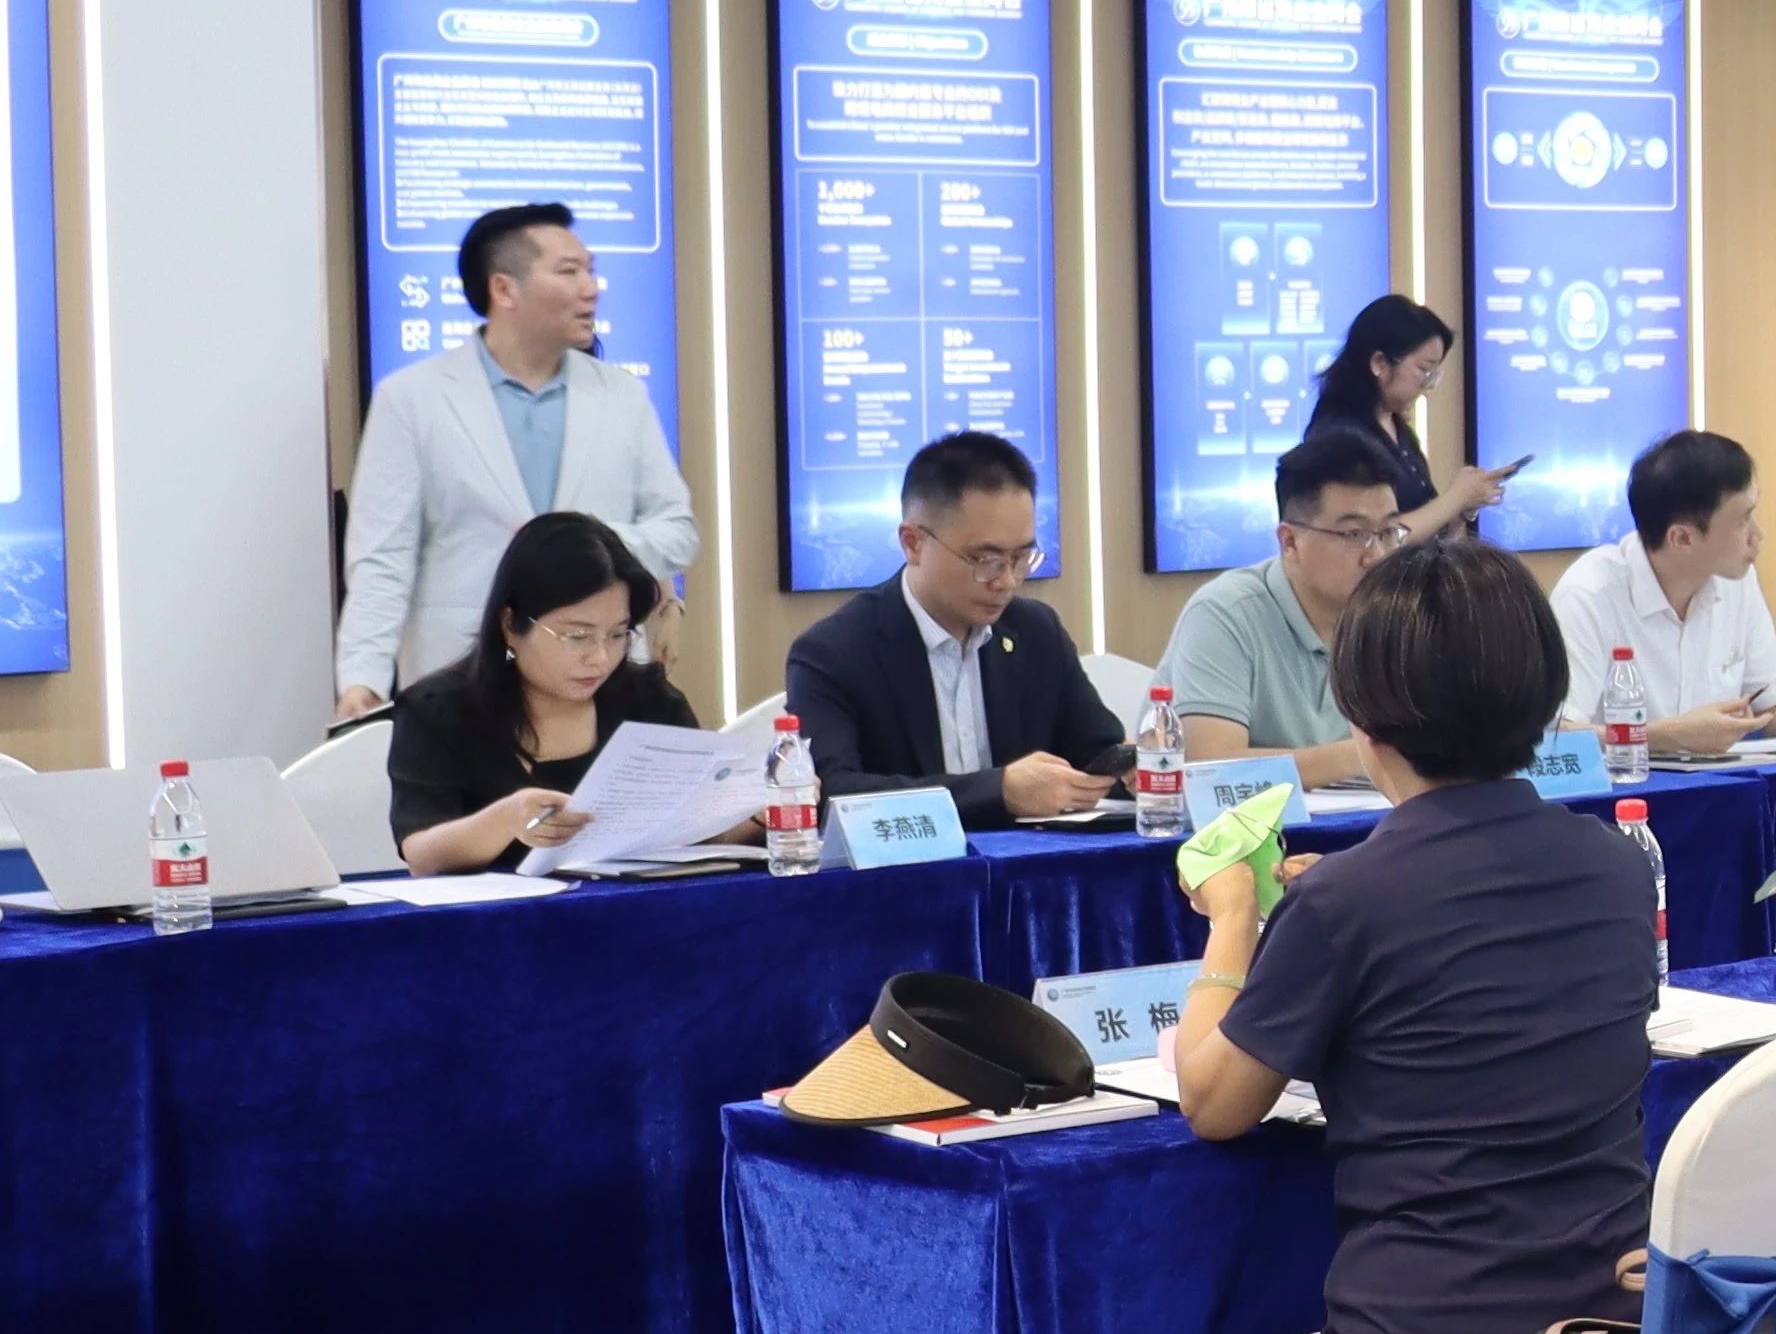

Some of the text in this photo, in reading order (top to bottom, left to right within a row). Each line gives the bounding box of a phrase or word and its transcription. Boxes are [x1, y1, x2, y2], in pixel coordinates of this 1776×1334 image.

[818, 180, 875, 201] 1,000+
[940, 181, 981, 201] 200+
[824, 329, 864, 348] 100+
[872, 814, 938, 842] 李燕清
[1094, 1008, 1130, 1043] 张
